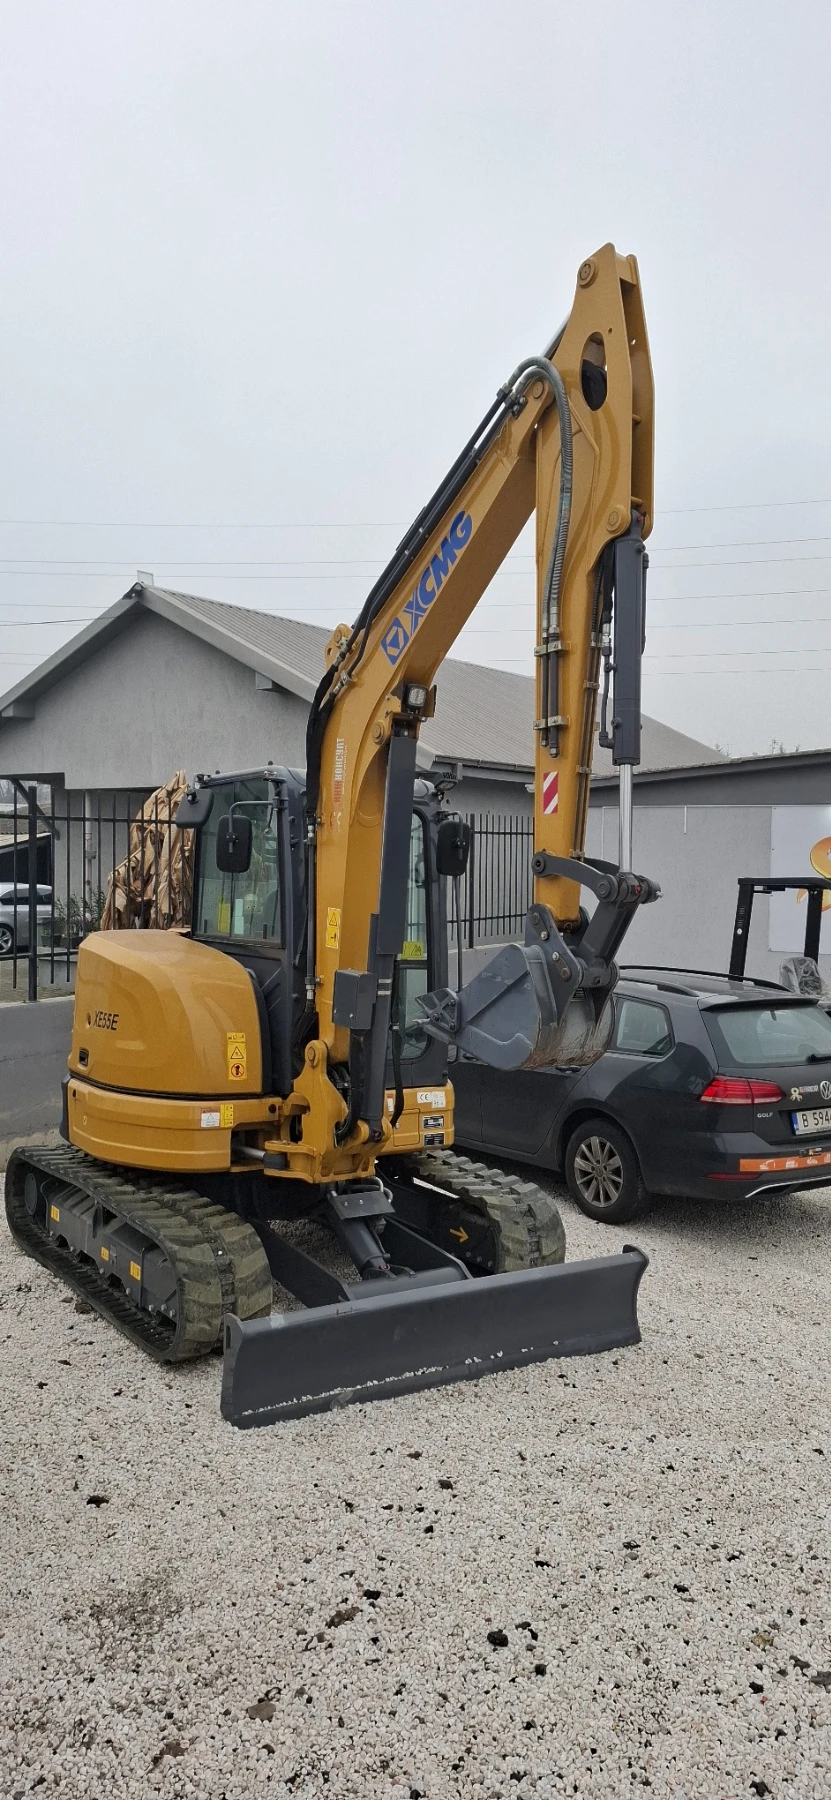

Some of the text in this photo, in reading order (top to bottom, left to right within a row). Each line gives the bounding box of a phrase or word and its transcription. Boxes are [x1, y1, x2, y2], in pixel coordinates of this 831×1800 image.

[403, 510, 473, 638] XCMG
[93, 1010, 119, 1030] XE55E
[813, 1110, 831, 1126] 594
